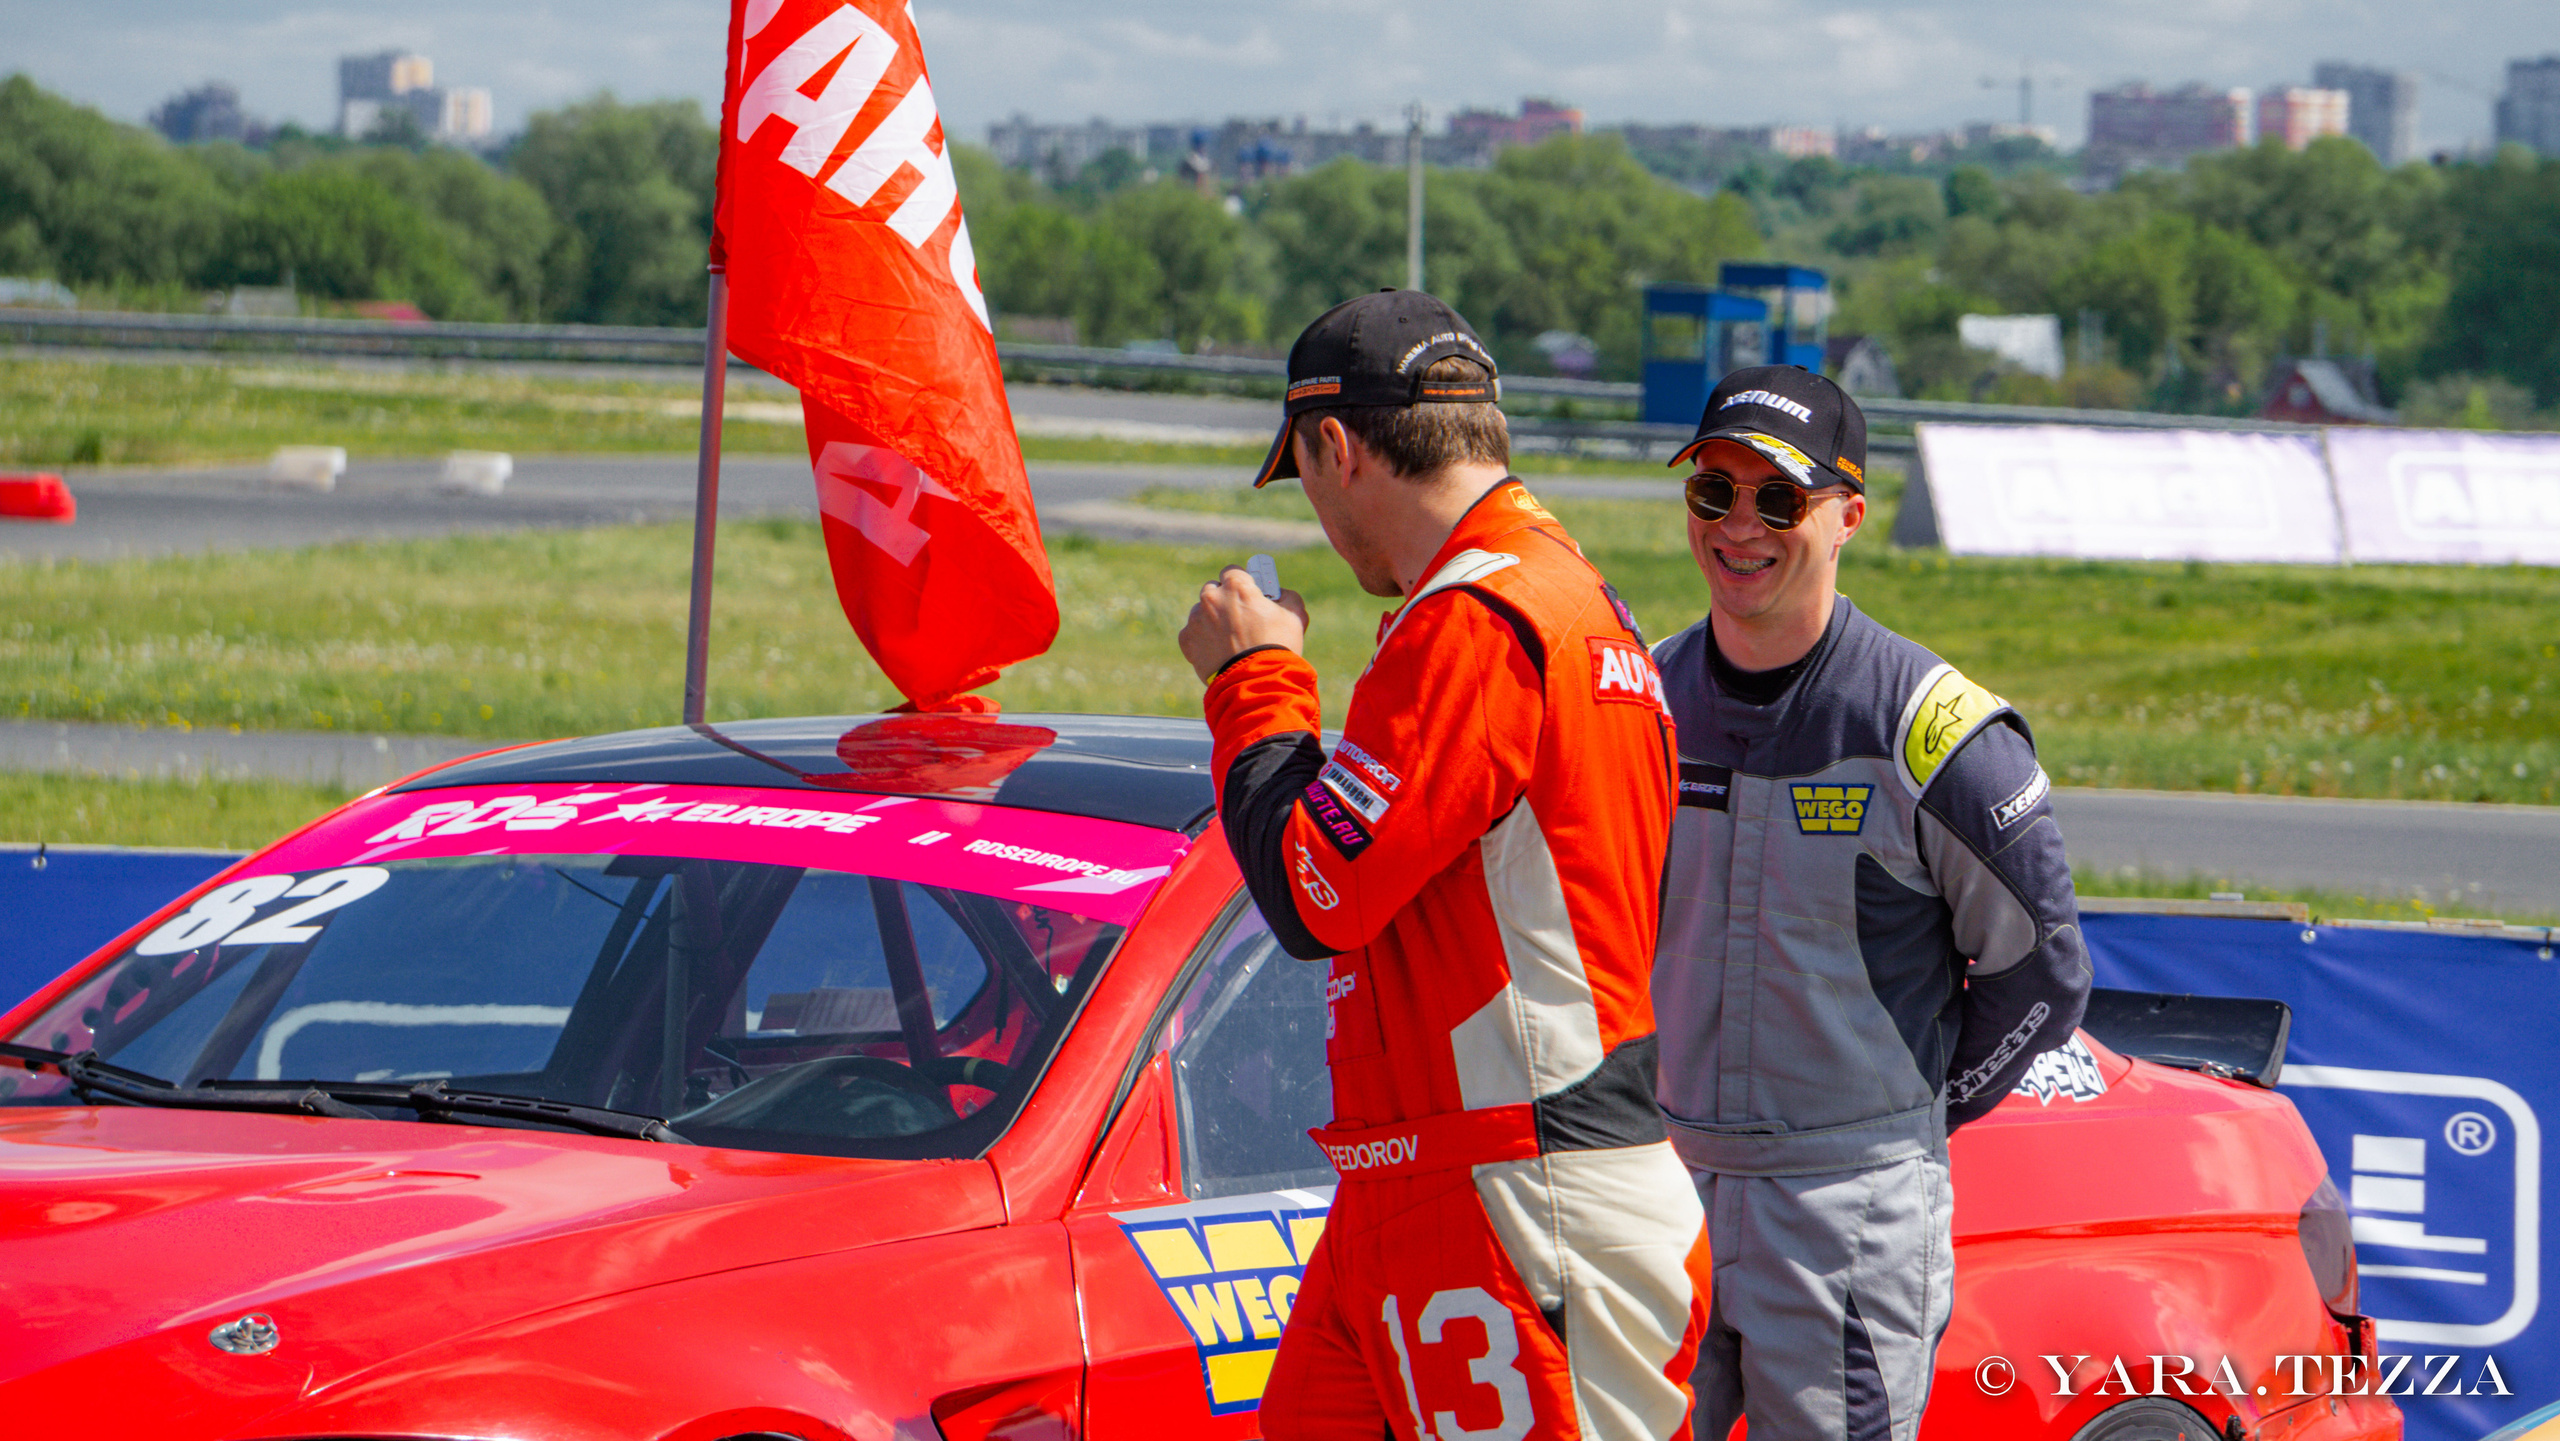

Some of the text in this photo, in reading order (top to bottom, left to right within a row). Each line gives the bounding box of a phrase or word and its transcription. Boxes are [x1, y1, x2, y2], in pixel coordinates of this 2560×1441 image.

[1396, 340, 1431, 374] MASUMA
[1431, 332, 1456, 345] AUTO
[1719, 390, 1812, 424] XENUM
[1337, 739, 1401, 792] UTOPROFI
[673, 803, 881, 833] EUROPE
[1795, 800, 1864, 819] WEGO
[963, 839, 1144, 885] RDSEUROPE.RU
[135, 866, 390, 957] 82
[1329, 1134, 1418, 1171] FEDOROV
[1382, 1286, 1535, 1441] 13
